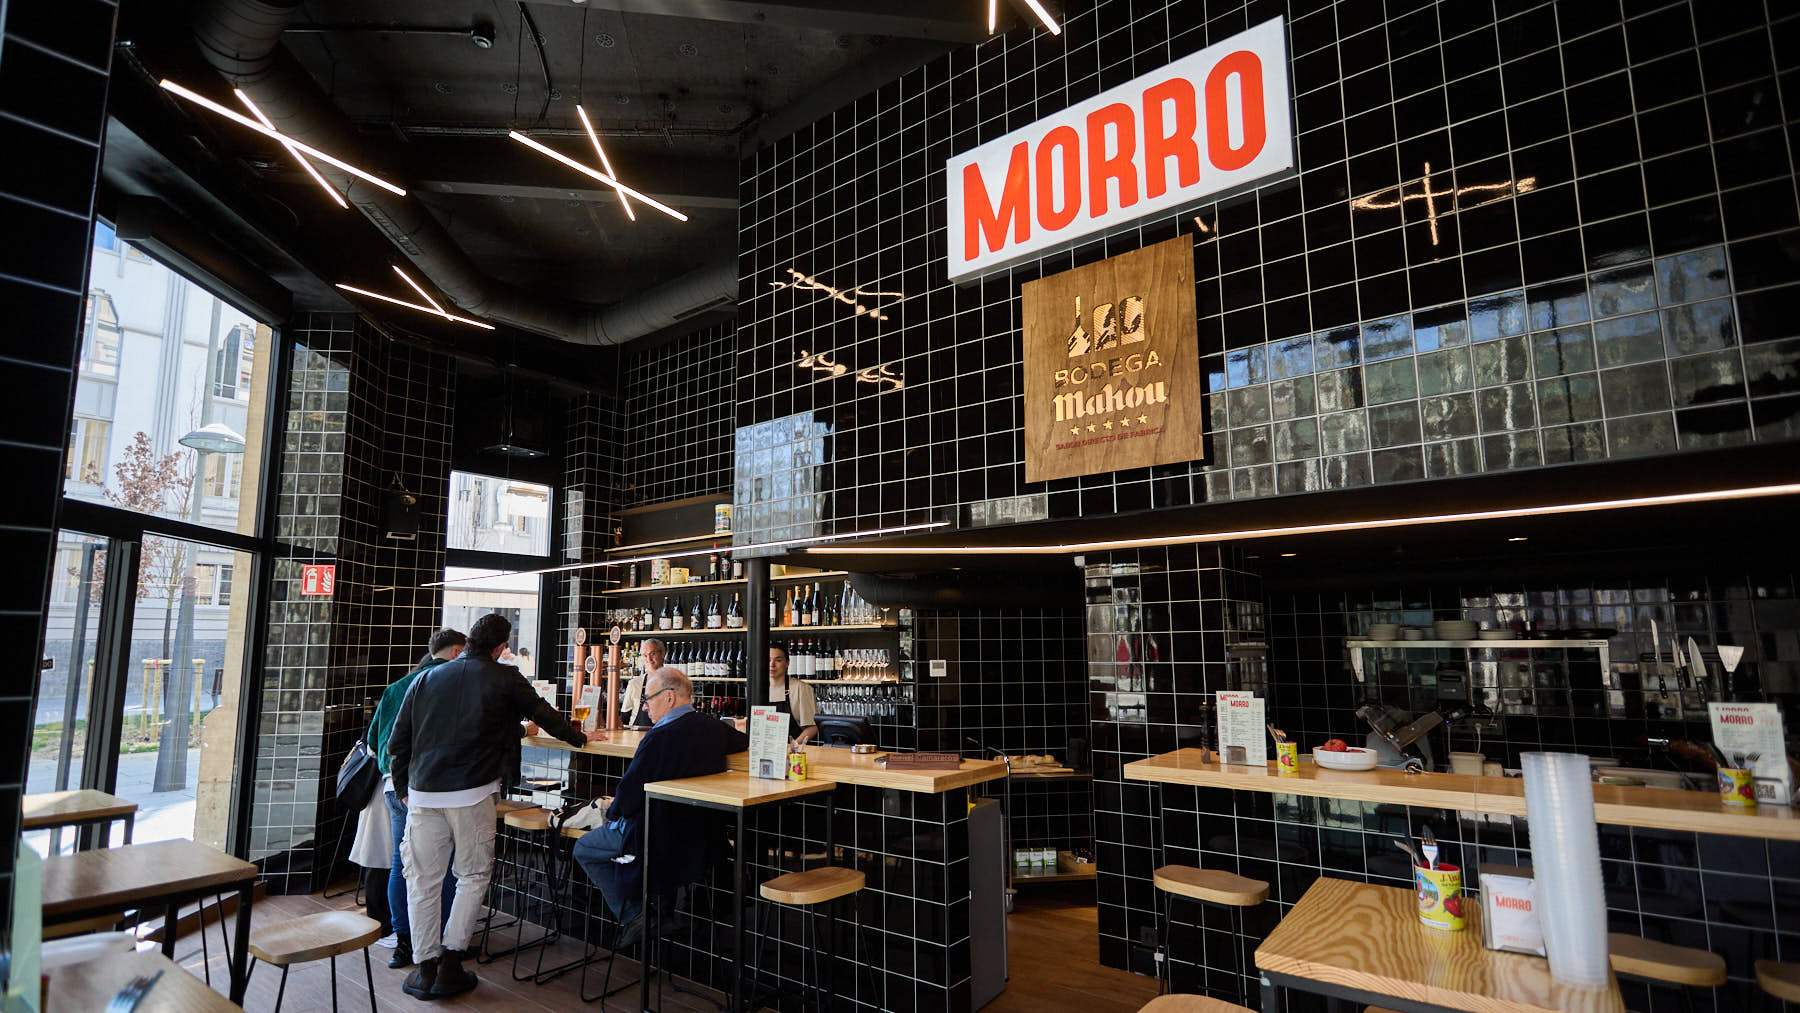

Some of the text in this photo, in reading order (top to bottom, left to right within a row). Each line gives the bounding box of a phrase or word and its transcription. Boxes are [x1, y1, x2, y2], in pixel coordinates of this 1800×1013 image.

[962, 50, 1267, 262] MORRO
[1054, 351, 1162, 388] BODEGA
[1053, 381, 1167, 422] Mahou
[1117, 432, 1128, 441] DE
[1720, 714, 1754, 725] MORRO
[1495, 896, 1532, 912] MORRO
